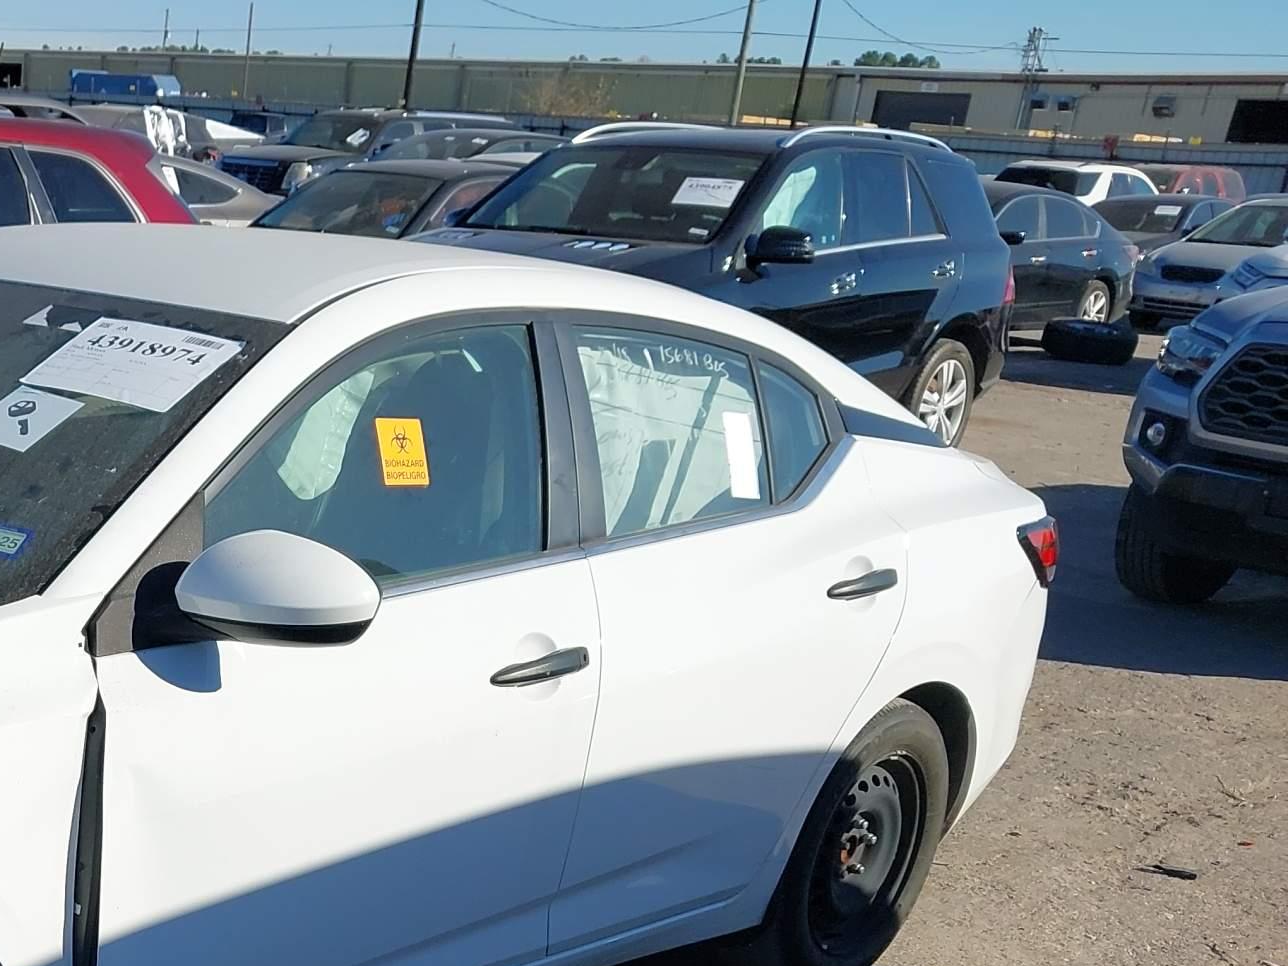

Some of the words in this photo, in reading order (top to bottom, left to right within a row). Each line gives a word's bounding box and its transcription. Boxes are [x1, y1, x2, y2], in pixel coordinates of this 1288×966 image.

[88, 334, 207, 365] 43918974
[384, 459, 425, 468] BIOHAZARD
[386, 471, 426, 480] BIOPELIGRO
